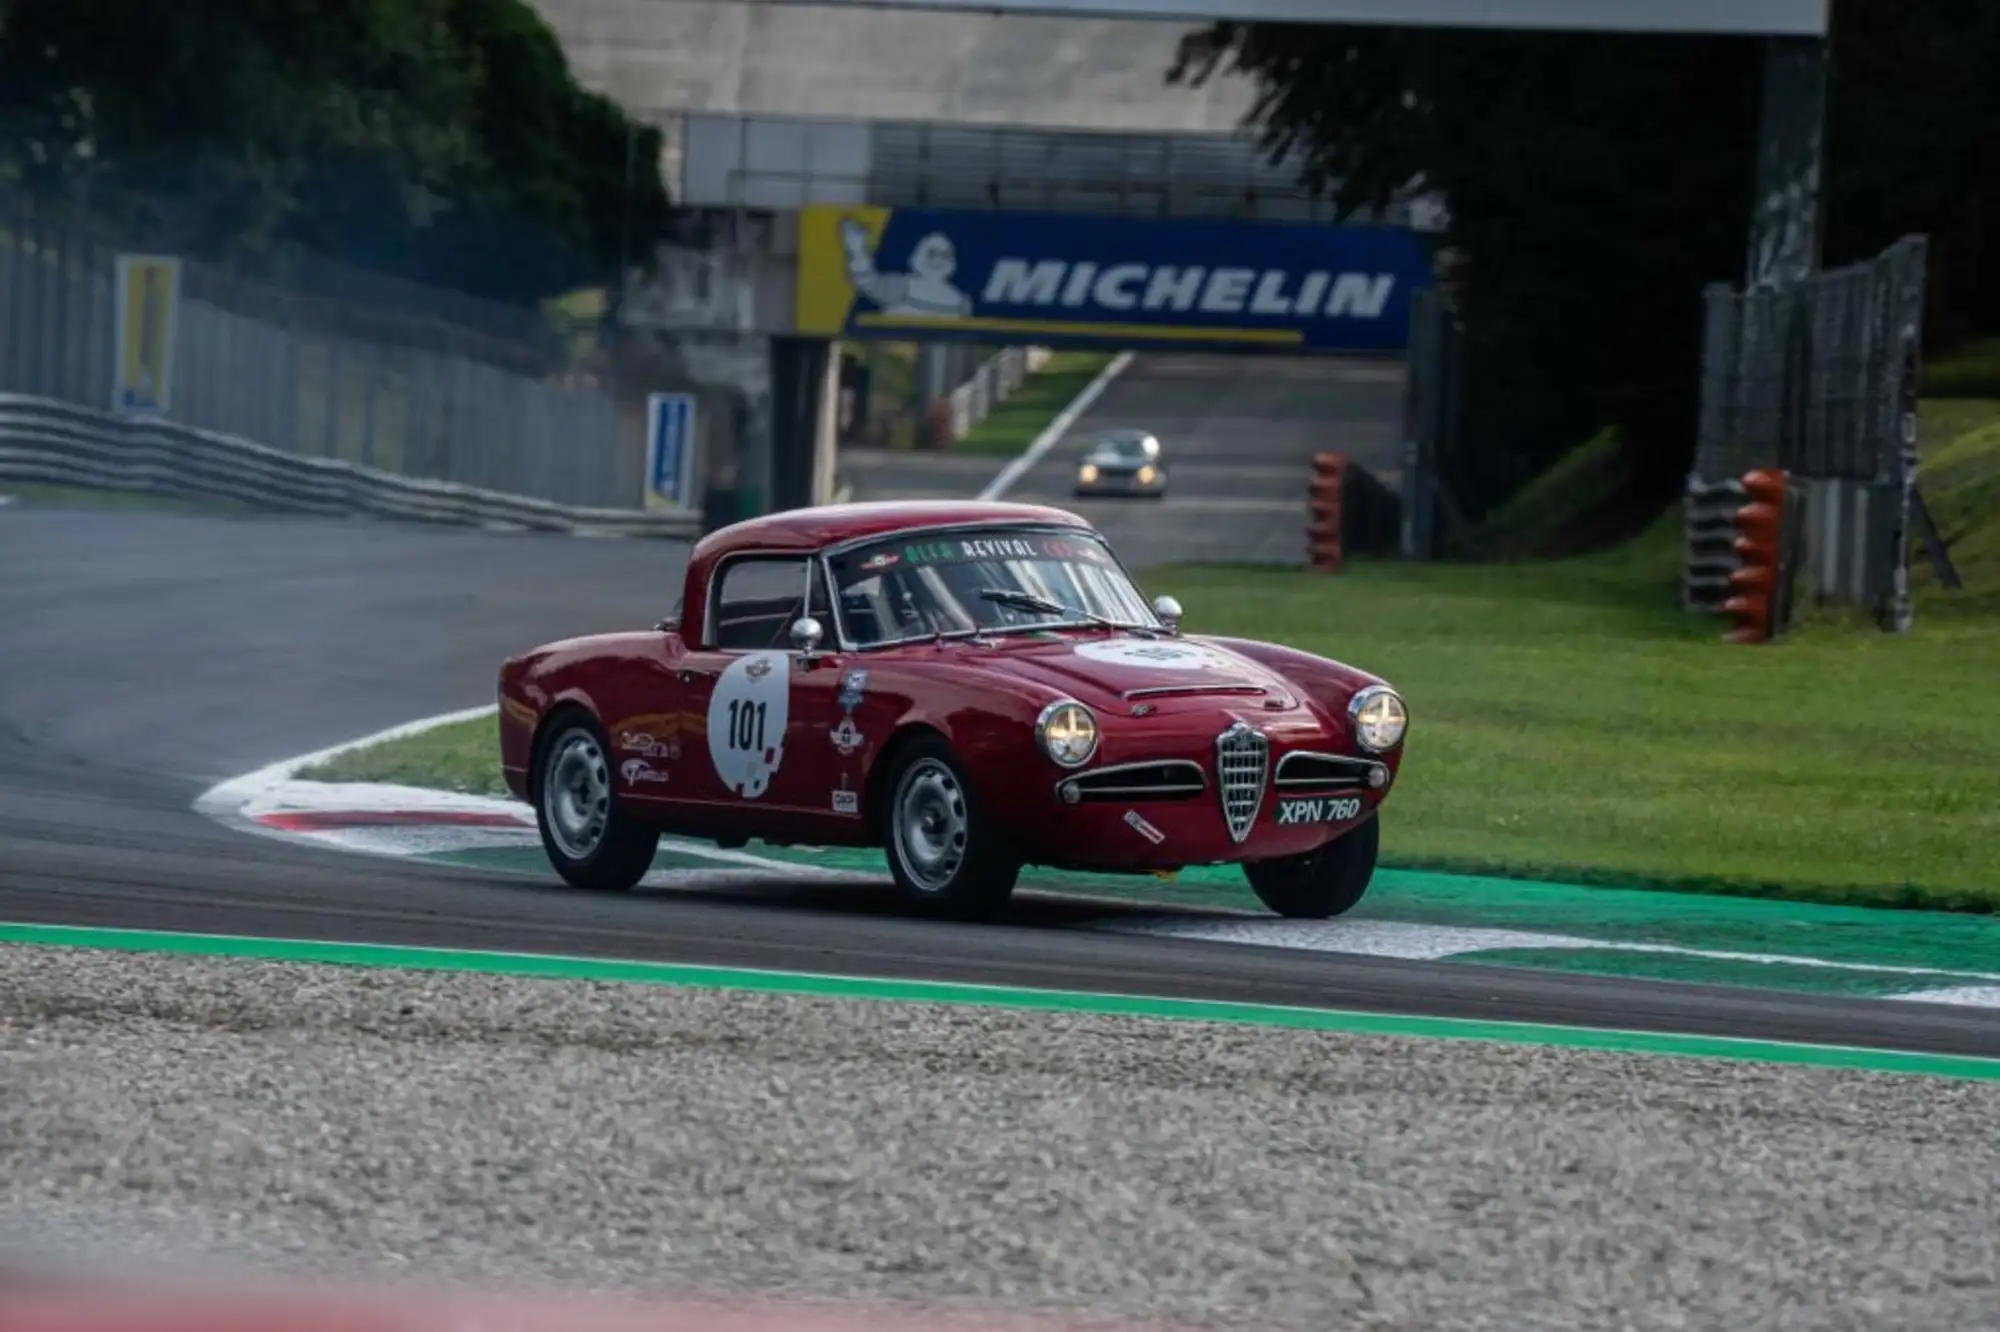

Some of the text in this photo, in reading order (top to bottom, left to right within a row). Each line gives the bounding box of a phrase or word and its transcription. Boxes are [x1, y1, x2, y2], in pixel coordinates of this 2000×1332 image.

[982, 257, 1395, 318] MICHELIN
[960, 539, 1038, 558] REVIVAL
[728, 698, 767, 752] 101
[1279, 798, 1361, 824] XPN 760
